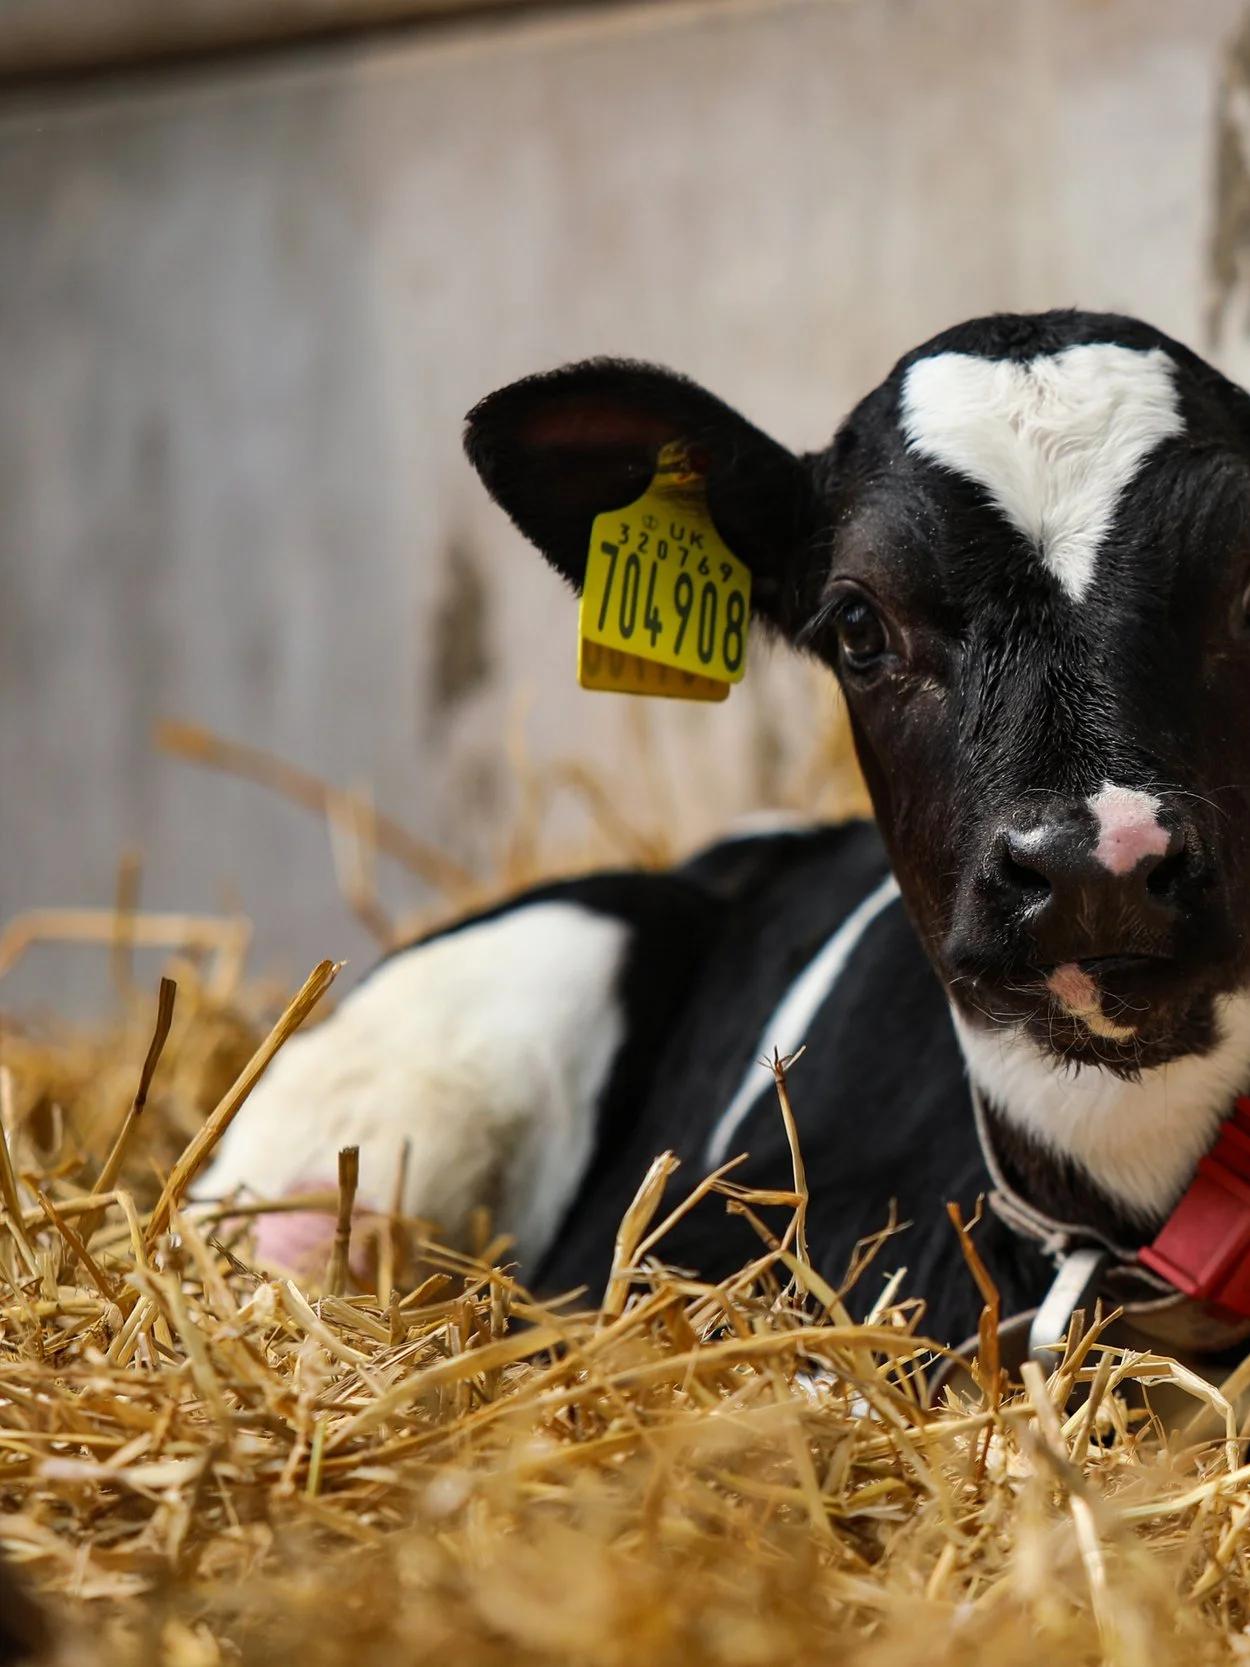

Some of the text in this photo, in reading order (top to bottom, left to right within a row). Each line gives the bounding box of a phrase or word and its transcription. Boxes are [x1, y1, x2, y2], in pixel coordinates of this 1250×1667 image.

[618, 522, 733, 583] 320769
[669, 521, 705, 550] UK
[597, 540, 746, 674] 704908
